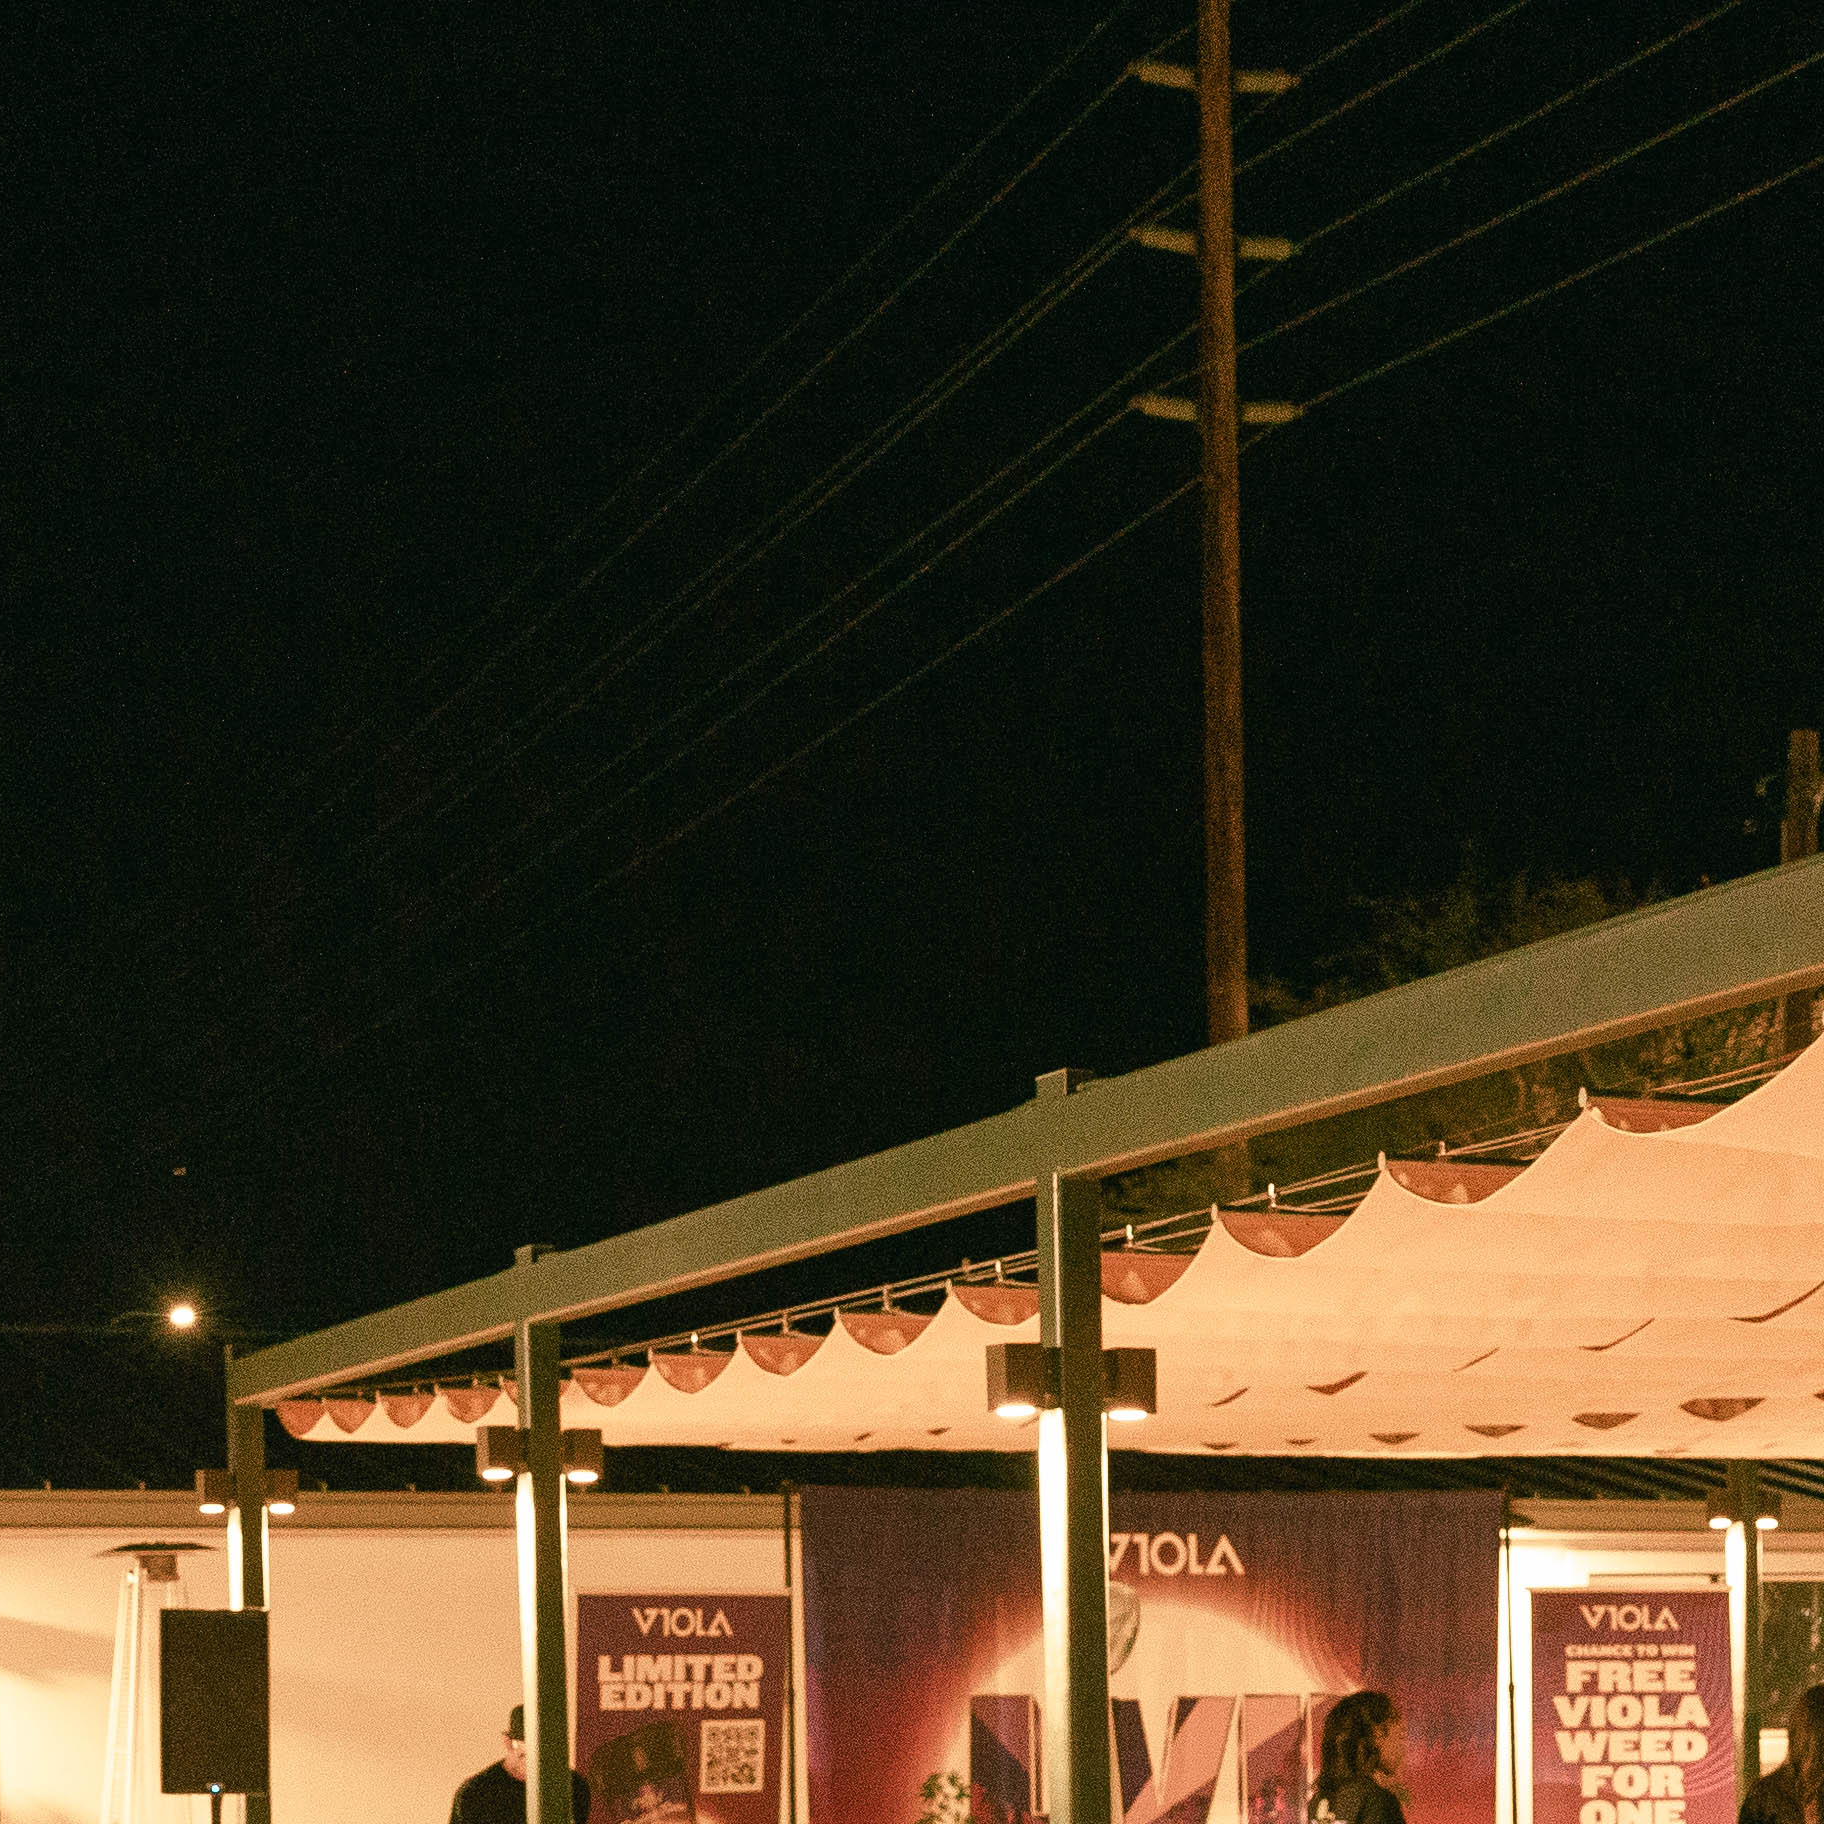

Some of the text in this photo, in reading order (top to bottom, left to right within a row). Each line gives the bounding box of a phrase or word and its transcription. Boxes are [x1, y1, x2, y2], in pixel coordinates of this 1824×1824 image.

[631, 1606, 734, 1638] VIOLA
[1580, 1605, 1680, 1632] VIOLA
[1565, 1644, 1697, 1658] CHANCE TO WIN
[597, 1653, 764, 1684] LIMITED
[1565, 1660, 1697, 1693] FREE
[599, 1682, 761, 1711] EDITION
[1553, 1695, 1710, 1728] VIOLA
[1556, 1730, 1709, 1763] WEED
[1581, 1764, 1685, 1798] FOR
